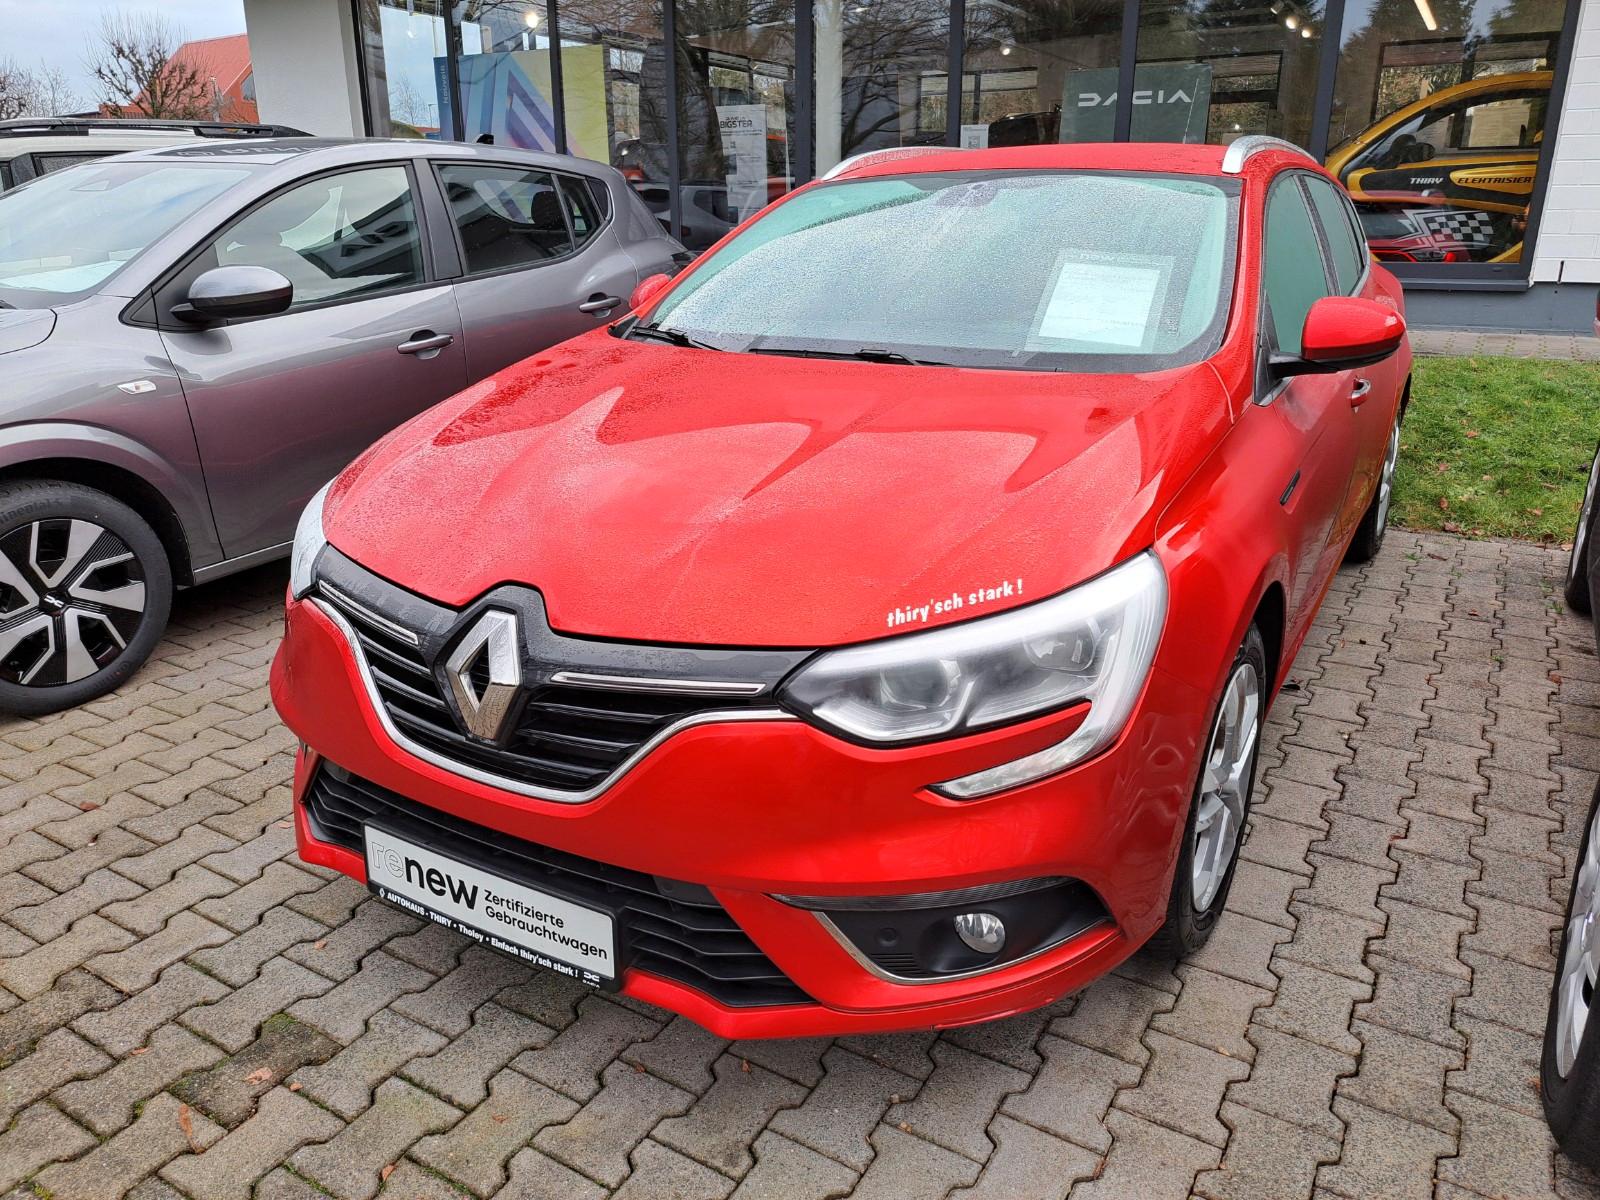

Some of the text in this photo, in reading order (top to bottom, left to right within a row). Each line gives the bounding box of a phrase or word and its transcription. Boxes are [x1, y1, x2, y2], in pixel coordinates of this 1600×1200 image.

[1078, 89, 1192, 107] DACIA
[720, 120, 753, 129] BIGSTER
[1457, 176, 1536, 184] ELEKTRISIER
[886, 592, 963, 628] thiry'sch
[968, 580, 1014, 606] stark
[371, 841, 479, 911] renew
[484, 889, 564, 929] Zertifizierte
[387, 891, 425, 916] AUTOHAUS
[429, 911, 453, 928] THIRY
[458, 923, 484, 943] Tholey
[491, 937, 519, 955] Einfach
[520, 948, 552, 969] thiry'sch
[553, 962, 574, 976] stark
[485, 905, 608, 960] Gebrauchtwagen
